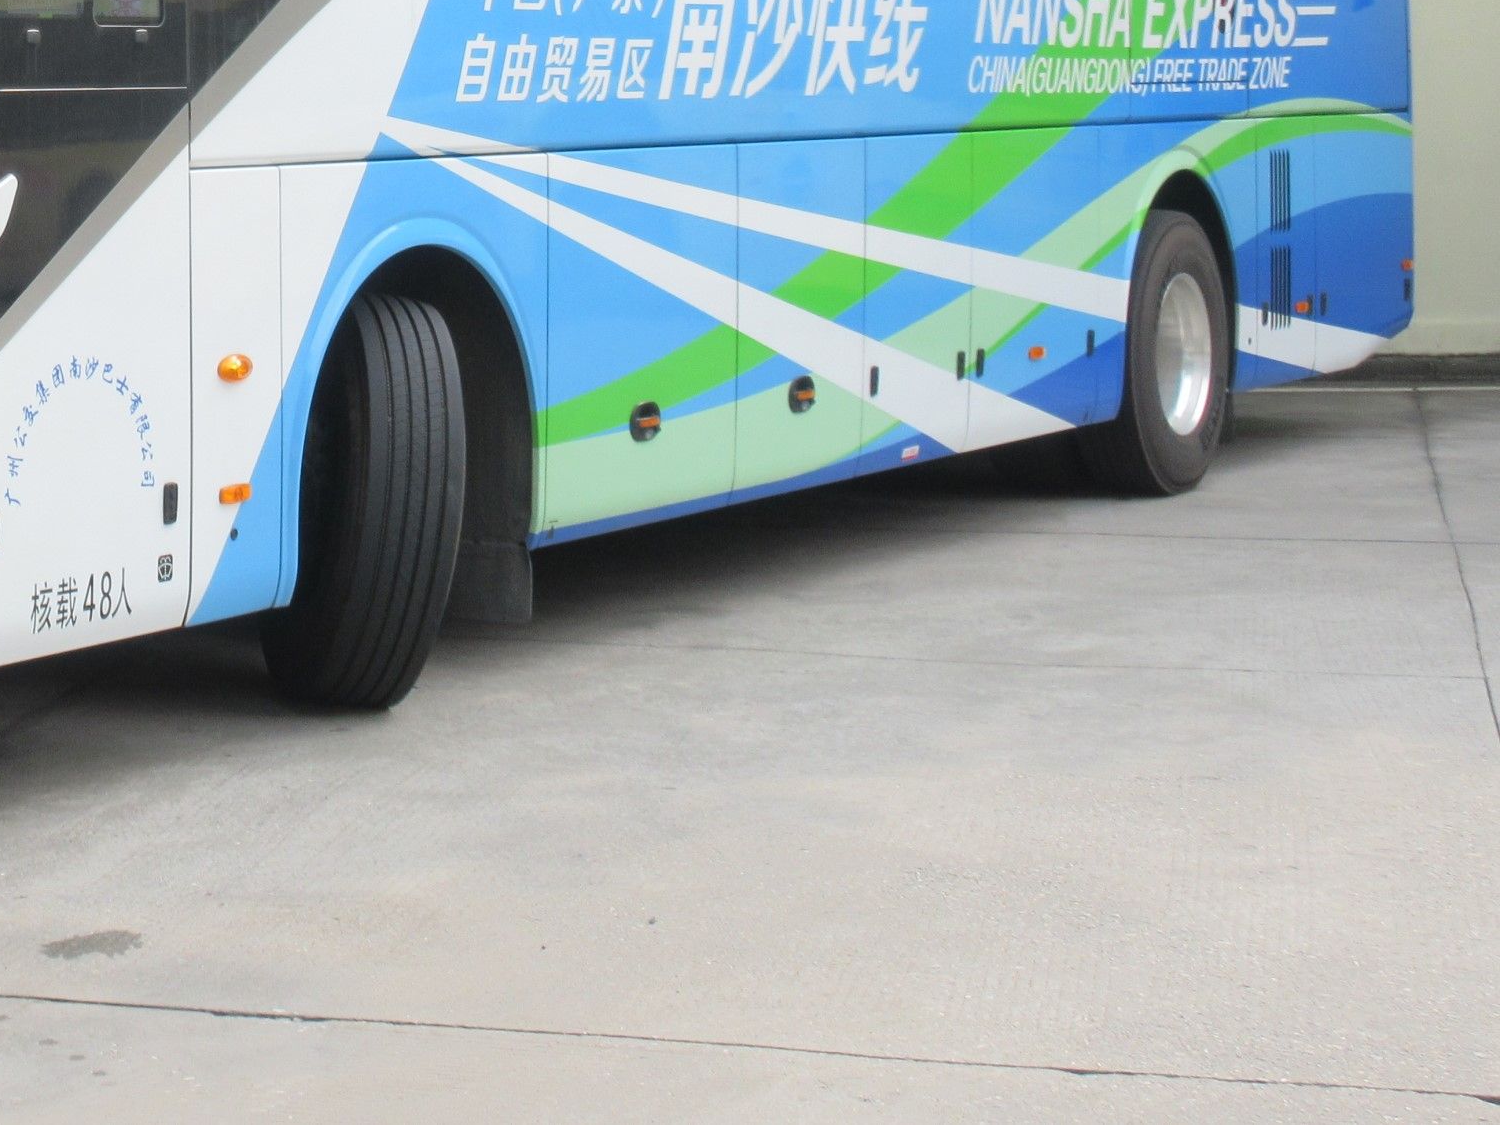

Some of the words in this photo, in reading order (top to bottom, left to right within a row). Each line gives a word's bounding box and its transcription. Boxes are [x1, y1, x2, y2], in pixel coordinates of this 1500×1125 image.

[455, 32, 654, 103] 自由贸易区
[1152, 57, 1195, 92] FREE
[1198, 57, 1248, 92] TRADE
[1249, 56, 1292, 90] ZONE
